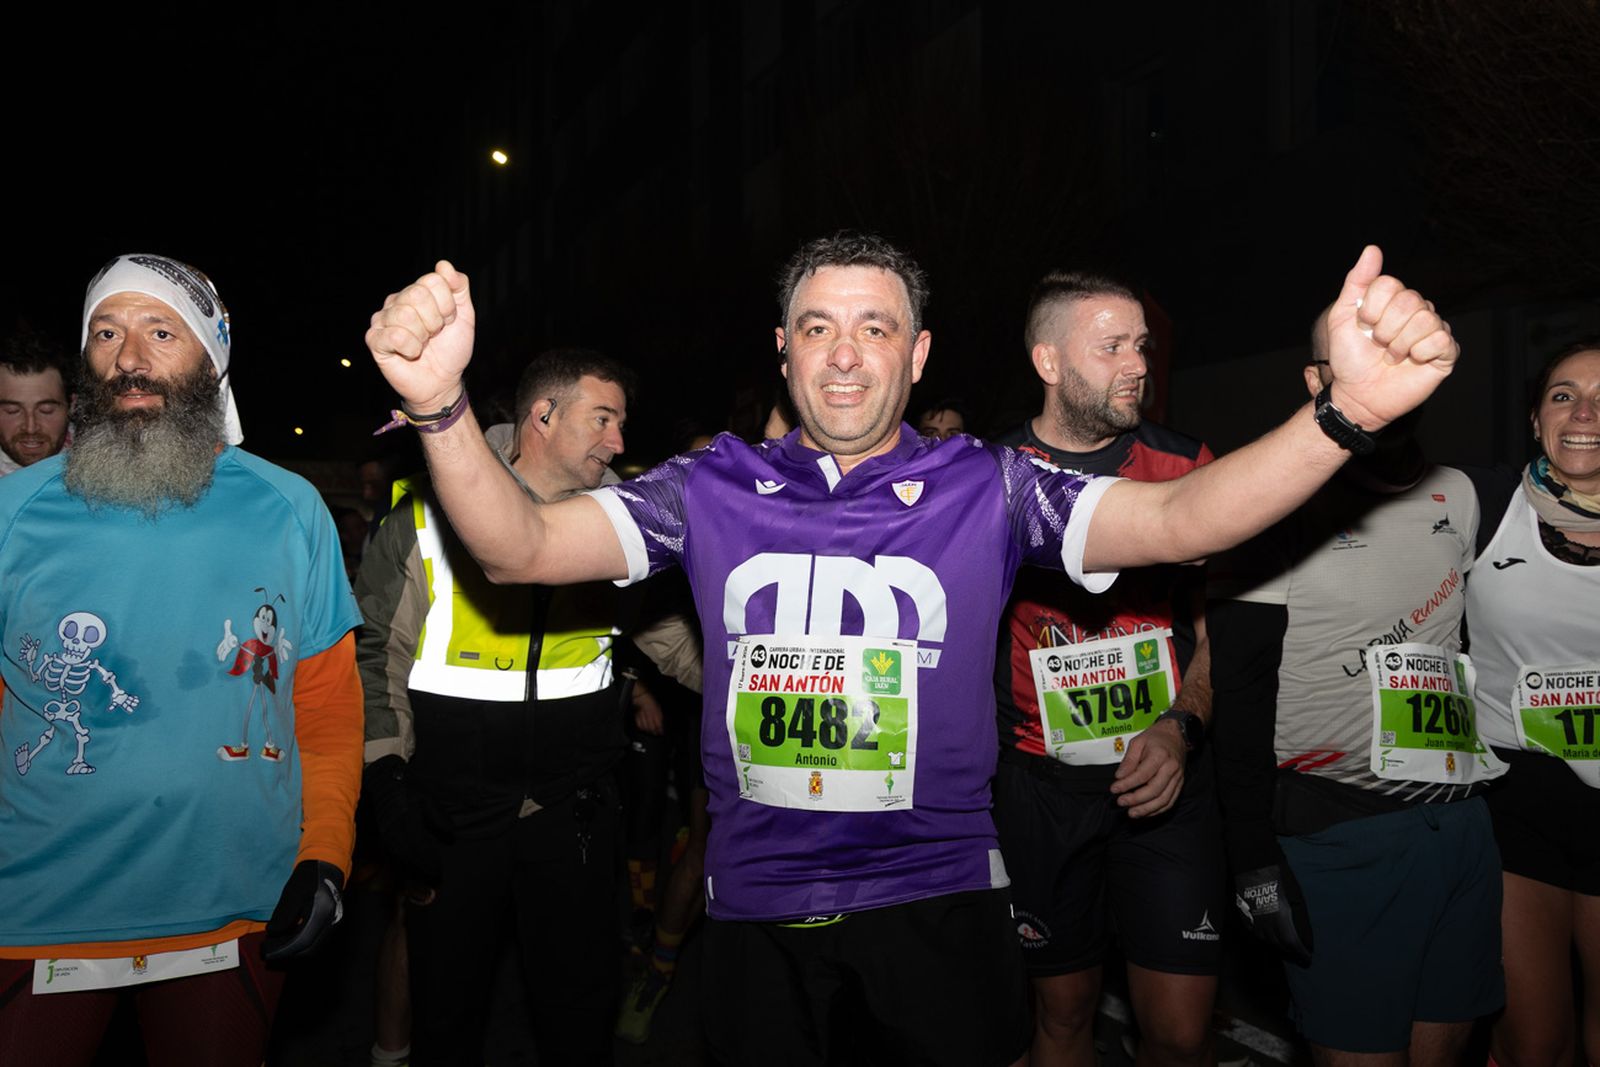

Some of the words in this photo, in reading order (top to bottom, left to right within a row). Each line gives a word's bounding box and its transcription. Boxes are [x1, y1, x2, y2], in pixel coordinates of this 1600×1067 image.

[1410, 568, 1460, 625] RUNNING
[751, 650, 765, 661] 43
[824, 655, 845, 671] DE
[1064, 654, 1105, 672] NOCHE
[1108, 652, 1123, 665] DE
[1406, 658, 1442, 673] NOCHE
[748, 673, 781, 692] SAN
[783, 671, 845, 694] ANTÓN
[1051, 674, 1078, 690] SAN
[1081, 664, 1126, 687] ANTÓN
[1389, 674, 1419, 689] SAN
[1546, 675, 1593, 690] NOCHE
[1067, 679, 1153, 727] 5794
[1530, 692, 1561, 707] SAN
[759, 696, 880, 751] 8482
[1101, 723, 1133, 737] Antonio
[1554, 708, 1600, 746] 17
[1424, 737, 1445, 748] Juan
[795, 753, 837, 767] Antonio
